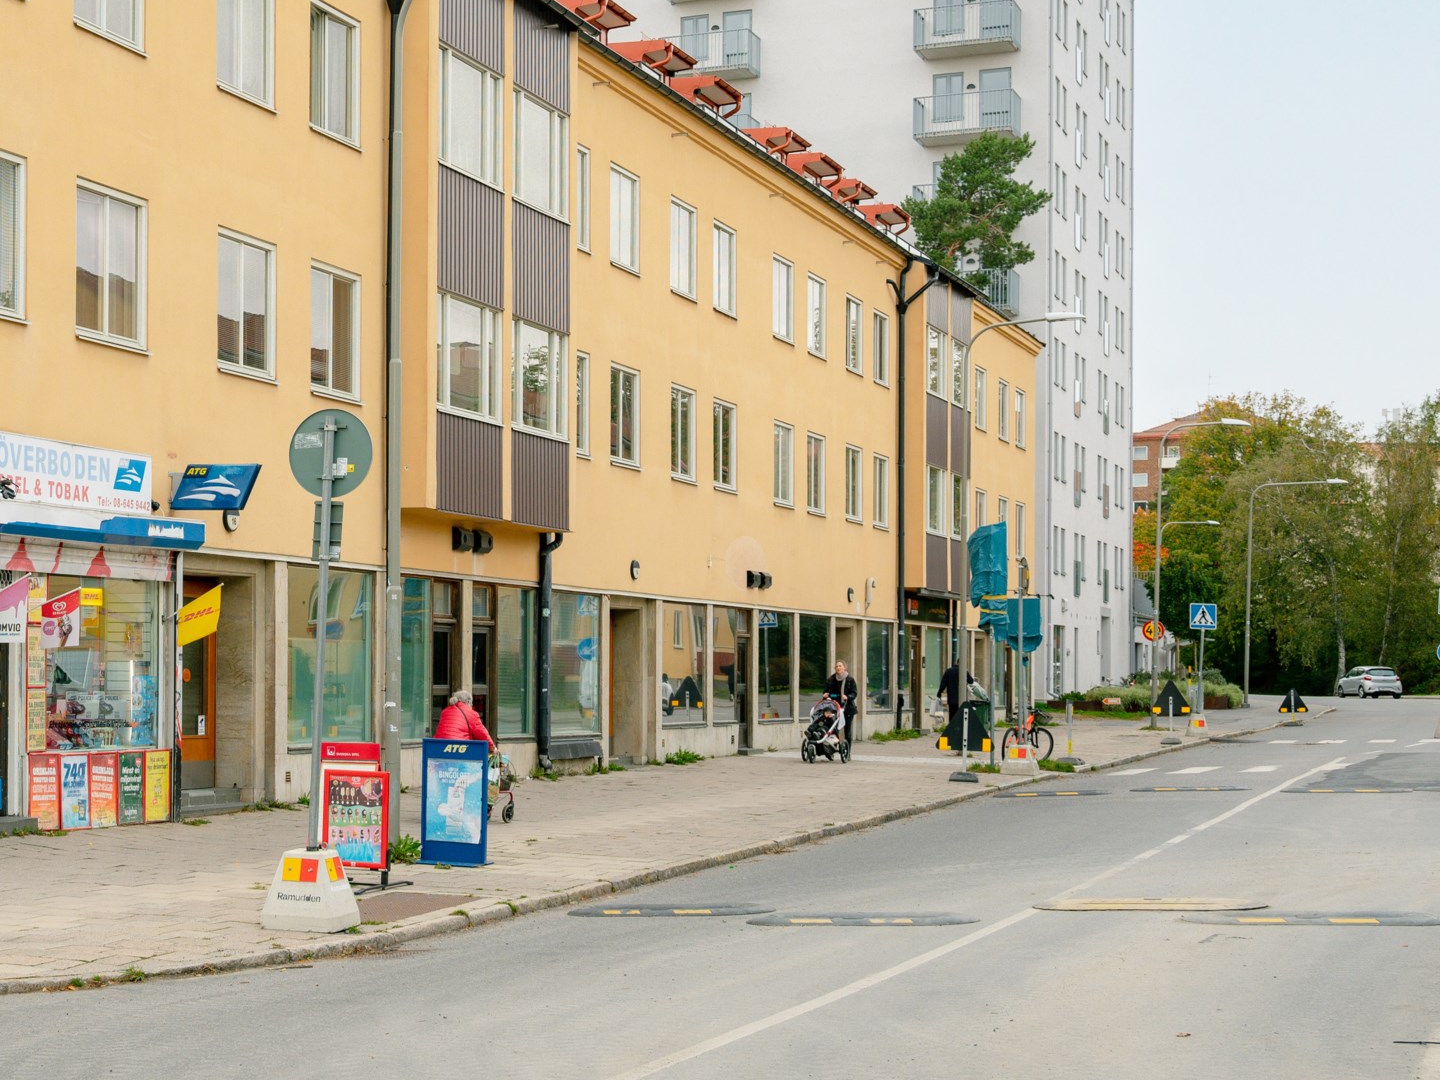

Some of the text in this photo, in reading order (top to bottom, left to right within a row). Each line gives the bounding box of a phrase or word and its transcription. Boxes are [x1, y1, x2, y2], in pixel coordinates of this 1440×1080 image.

[187, 467, 208, 476] ATG
[34, 479, 42, 496] &
[48, 480, 89, 503] TOBAK
[113, 498, 134, 509] 08-645
[135, 501, 150, 512] 9442
[183, 606, 215, 622] DHL
[443, 744, 467, 753] ATG
[63, 762, 86, 780] 740
